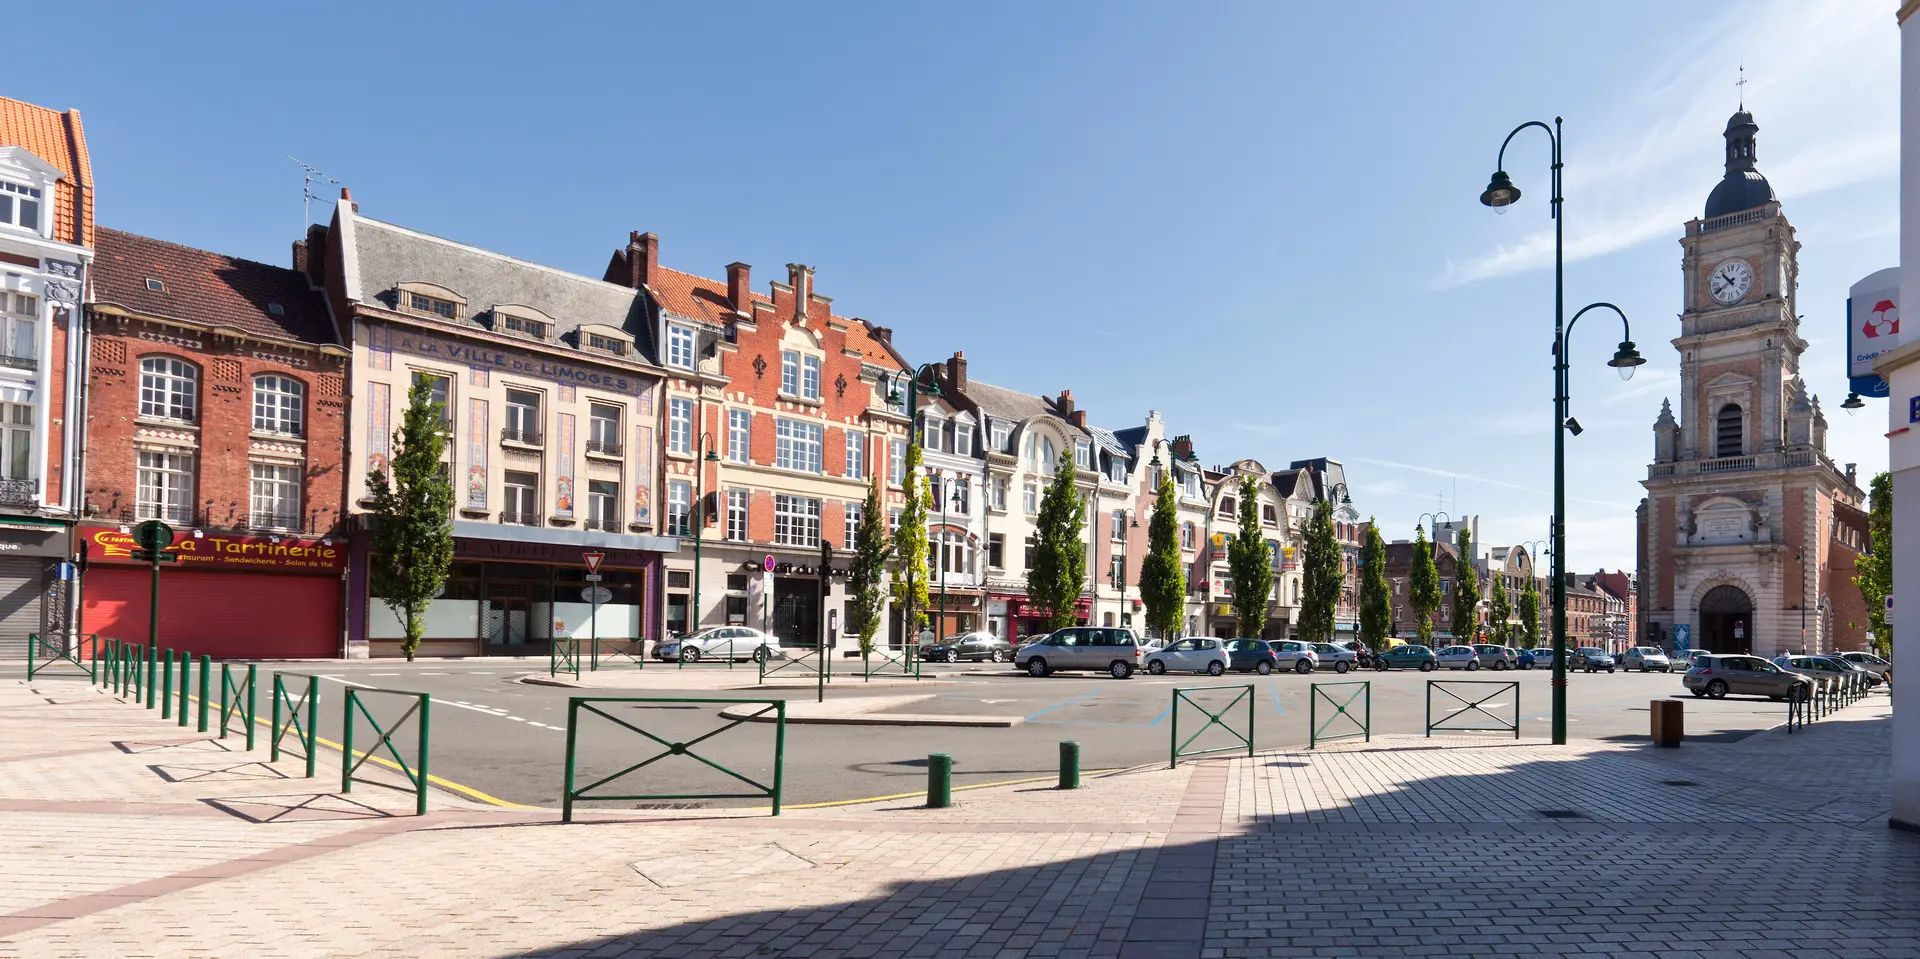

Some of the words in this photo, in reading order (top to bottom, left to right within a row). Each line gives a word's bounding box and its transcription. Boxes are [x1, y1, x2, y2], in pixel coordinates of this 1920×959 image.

[419, 343, 438, 353] LA
[447, 344, 506, 366] VILLE
[513, 360, 533, 371] DE
[541, 363, 628, 389] LIMOGES
[209, 538, 336, 559] Tartinerie
[177, 554, 215, 562] staurant
[224, 556, 277, 565] Sandwicherie
[285, 559, 307, 567] Salon
